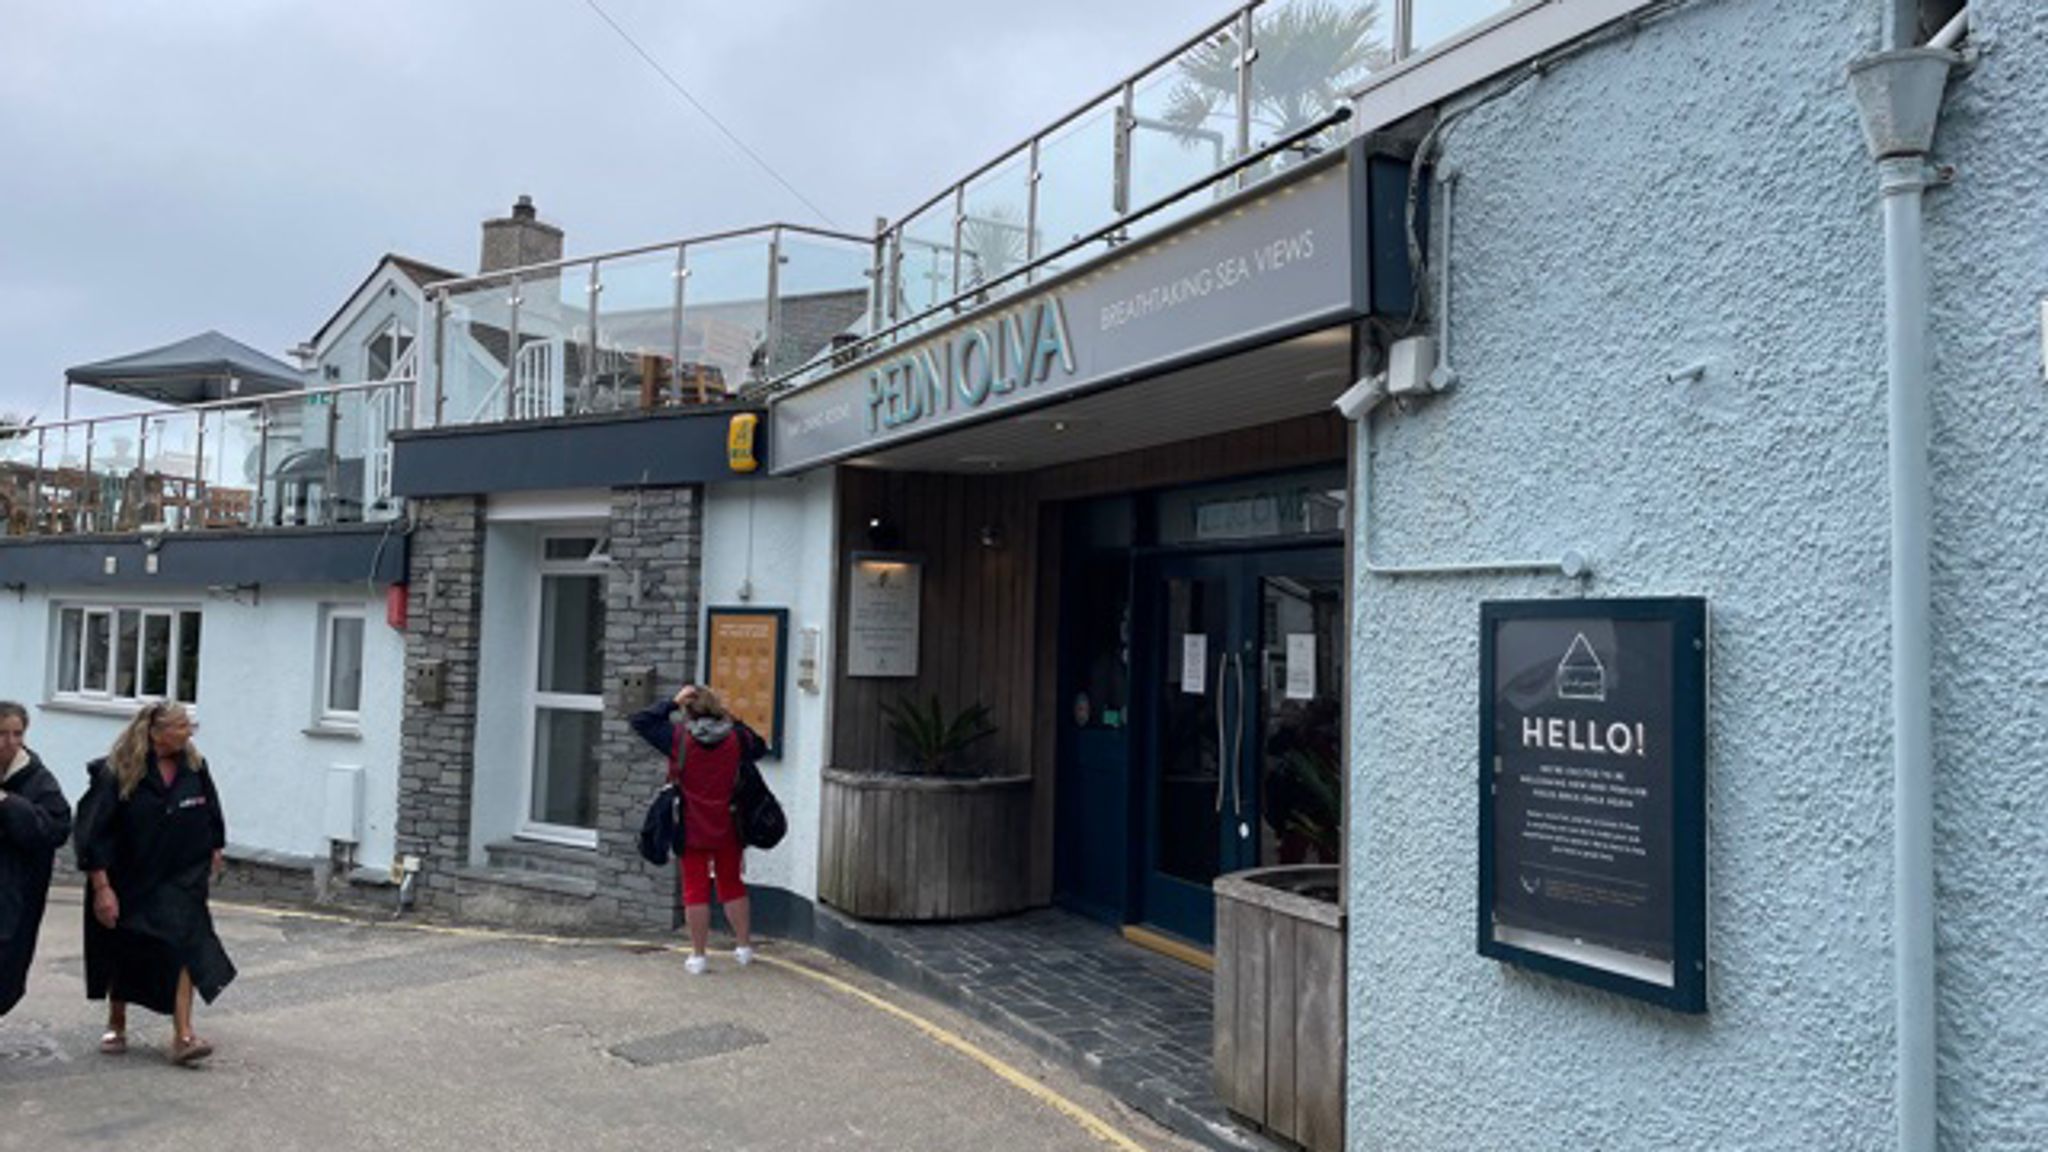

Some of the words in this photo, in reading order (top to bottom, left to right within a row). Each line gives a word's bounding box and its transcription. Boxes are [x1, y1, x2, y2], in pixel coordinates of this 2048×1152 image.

[1100, 268, 1211, 332] BREATHTAKING
[1215, 257, 1250, 290] SEA
[1254, 228, 1314, 272] VIEWS
[863, 340, 953, 433] PEDN
[957, 293, 1075, 407] OLVA
[1522, 716, 1645, 757] HELLO!
